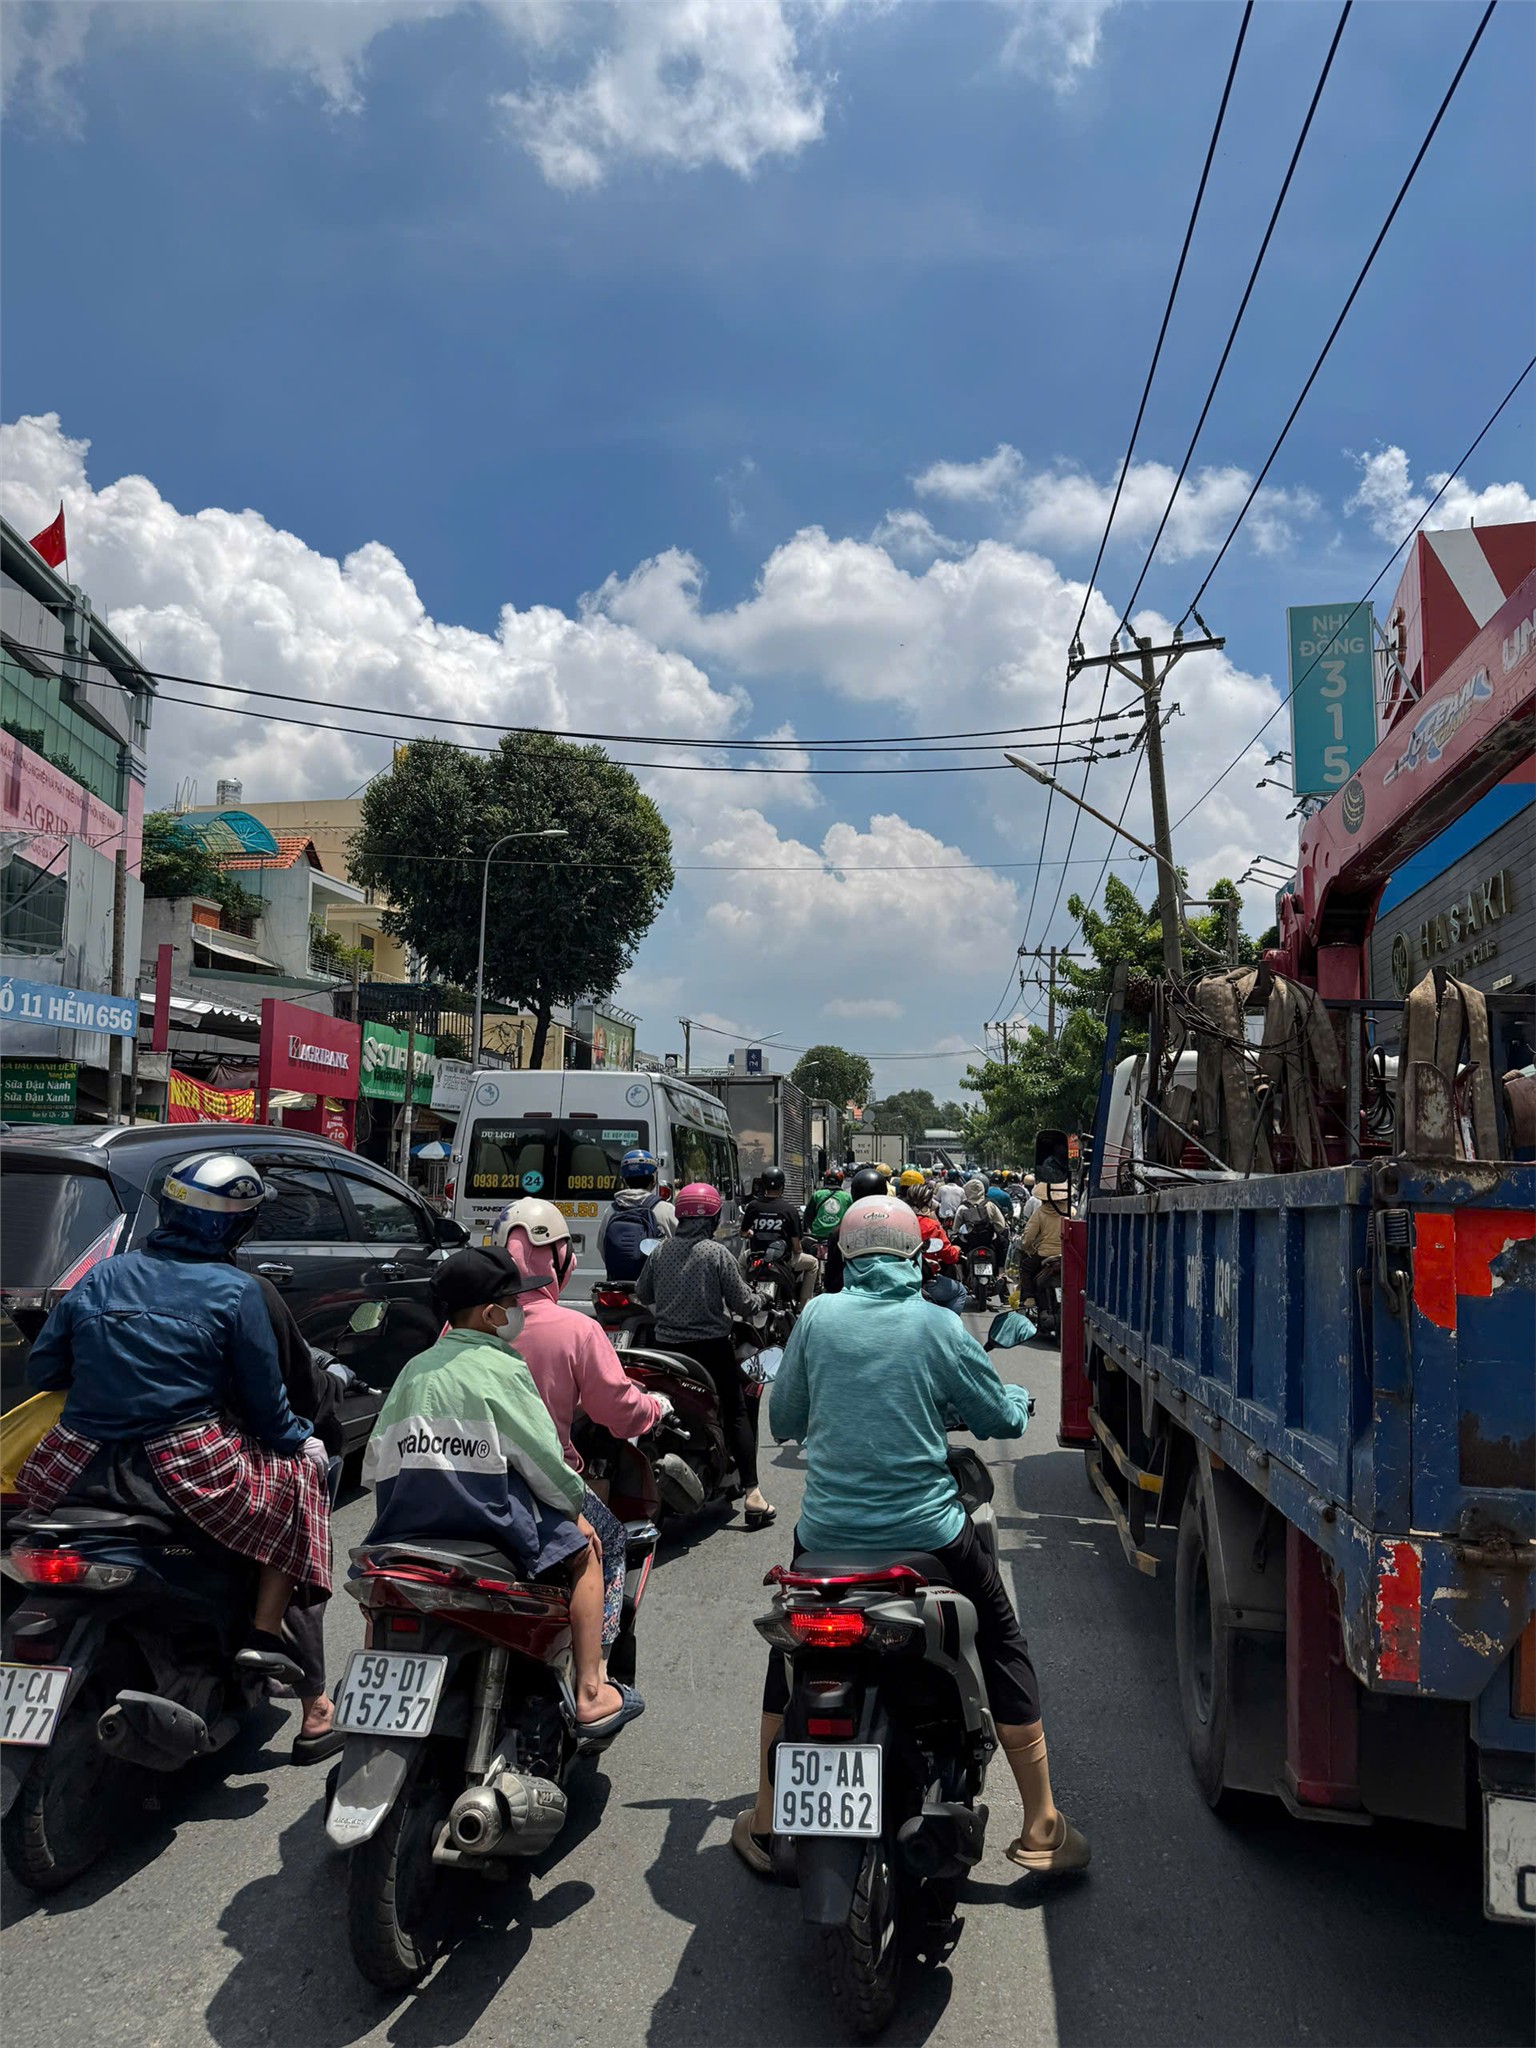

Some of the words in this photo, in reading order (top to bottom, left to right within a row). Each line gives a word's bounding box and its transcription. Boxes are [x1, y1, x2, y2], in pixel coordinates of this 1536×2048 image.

[1312, 613, 1349, 632] NHI
[1299, 633, 1365, 656] ĐỒNG
[1420, 869, 1508, 959] HASAKI
[19, 993, 43, 1018] 11
[48, 991, 94, 1025] HẺM
[96, 1005, 132, 1031] 656
[300, 1043, 349, 1070] AGRIBANK
[5, 1080, 23, 1089] Sữa
[25, 1080, 45, 1091] Đậu
[4, 1092, 22, 1101] Sữa
[25, 1092, 44, 1103] Đậu
[46, 1093, 70, 1102] Xanh
[495, 1131, 515, 1140] LỊCH
[473, 1174, 498, 1188] 0938
[501, 1174, 519, 1188] 231
[524, 1176, 541, 1186] 24
[567, 1175, 594, 1189] 0983
[597, 1175, 617, 1189] 097
[753, 1218, 783, 1230] 1992
[342, 1691, 431, 1730] 157.57
[791, 1750, 865, 1787] 50-AA
[782, 1790, 872, 1829] 958.62
